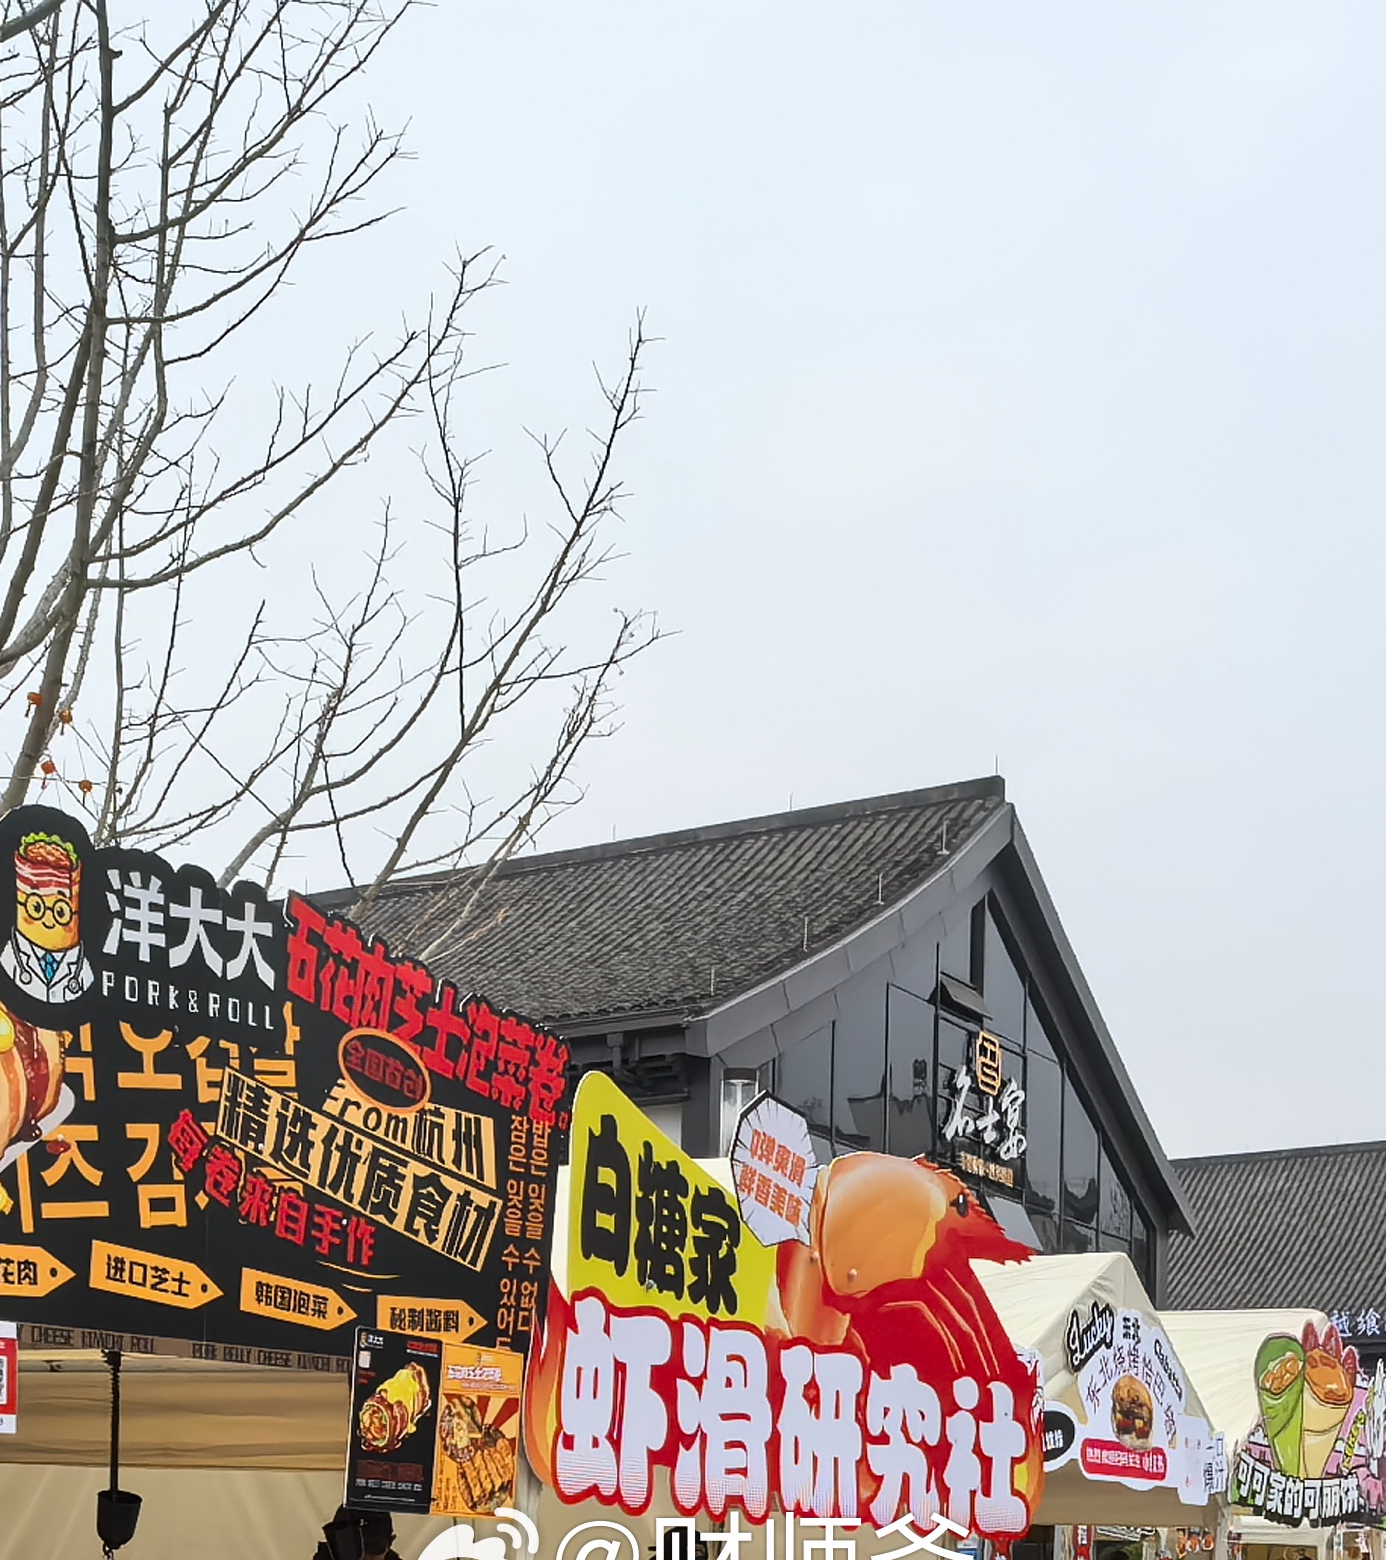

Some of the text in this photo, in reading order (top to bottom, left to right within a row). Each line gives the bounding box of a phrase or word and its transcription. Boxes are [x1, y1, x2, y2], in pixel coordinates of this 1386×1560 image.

[102, 867, 277, 993] 洋大大
[102, 971, 275, 1031] PORK&ROLL
[168, 1108, 375, 1266] 每卷来自手作
[224, 1069, 499, 1268] 精选优质食材
[581, 1114, 741, 1315] 白糖家
[105, 1255, 192, 1297] 进口芝士
[502, 1243, 519, 1272] 수
[523, 1247, 541, 1275] 수
[254, 1280, 328, 1319] 韩国泡菜
[390, 1307, 459, 1332] 秘制酱料
[1067, 1303, 1113, 1369] Lucky
[557, 1296, 1027, 1533] 虾滑研究社
[1239, 1451, 1358, 1519] 可可家的可丽饼
